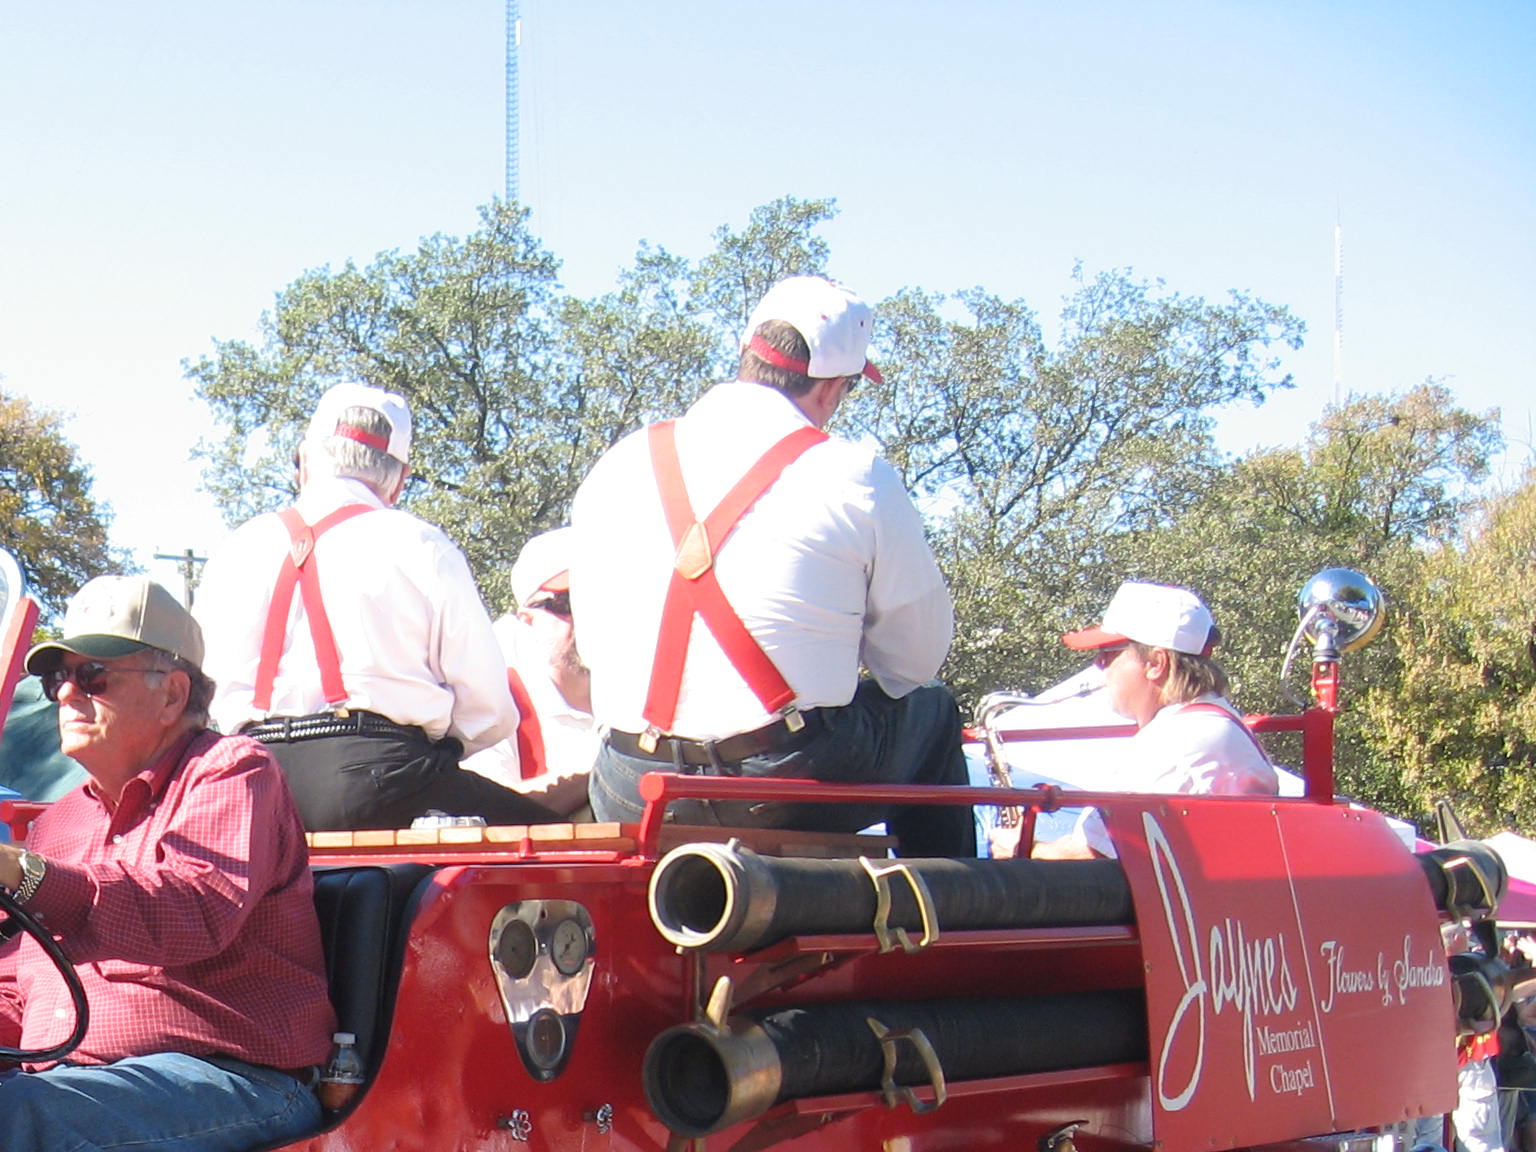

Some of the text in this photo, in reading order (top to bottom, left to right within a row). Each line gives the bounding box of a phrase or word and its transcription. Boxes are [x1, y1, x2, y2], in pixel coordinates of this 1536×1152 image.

[1320, 934, 1444, 1013] Flowers by Sandra
[1256, 1020, 1315, 1056] Memorial
[1270, 1060, 1314, 1096] Chapel
